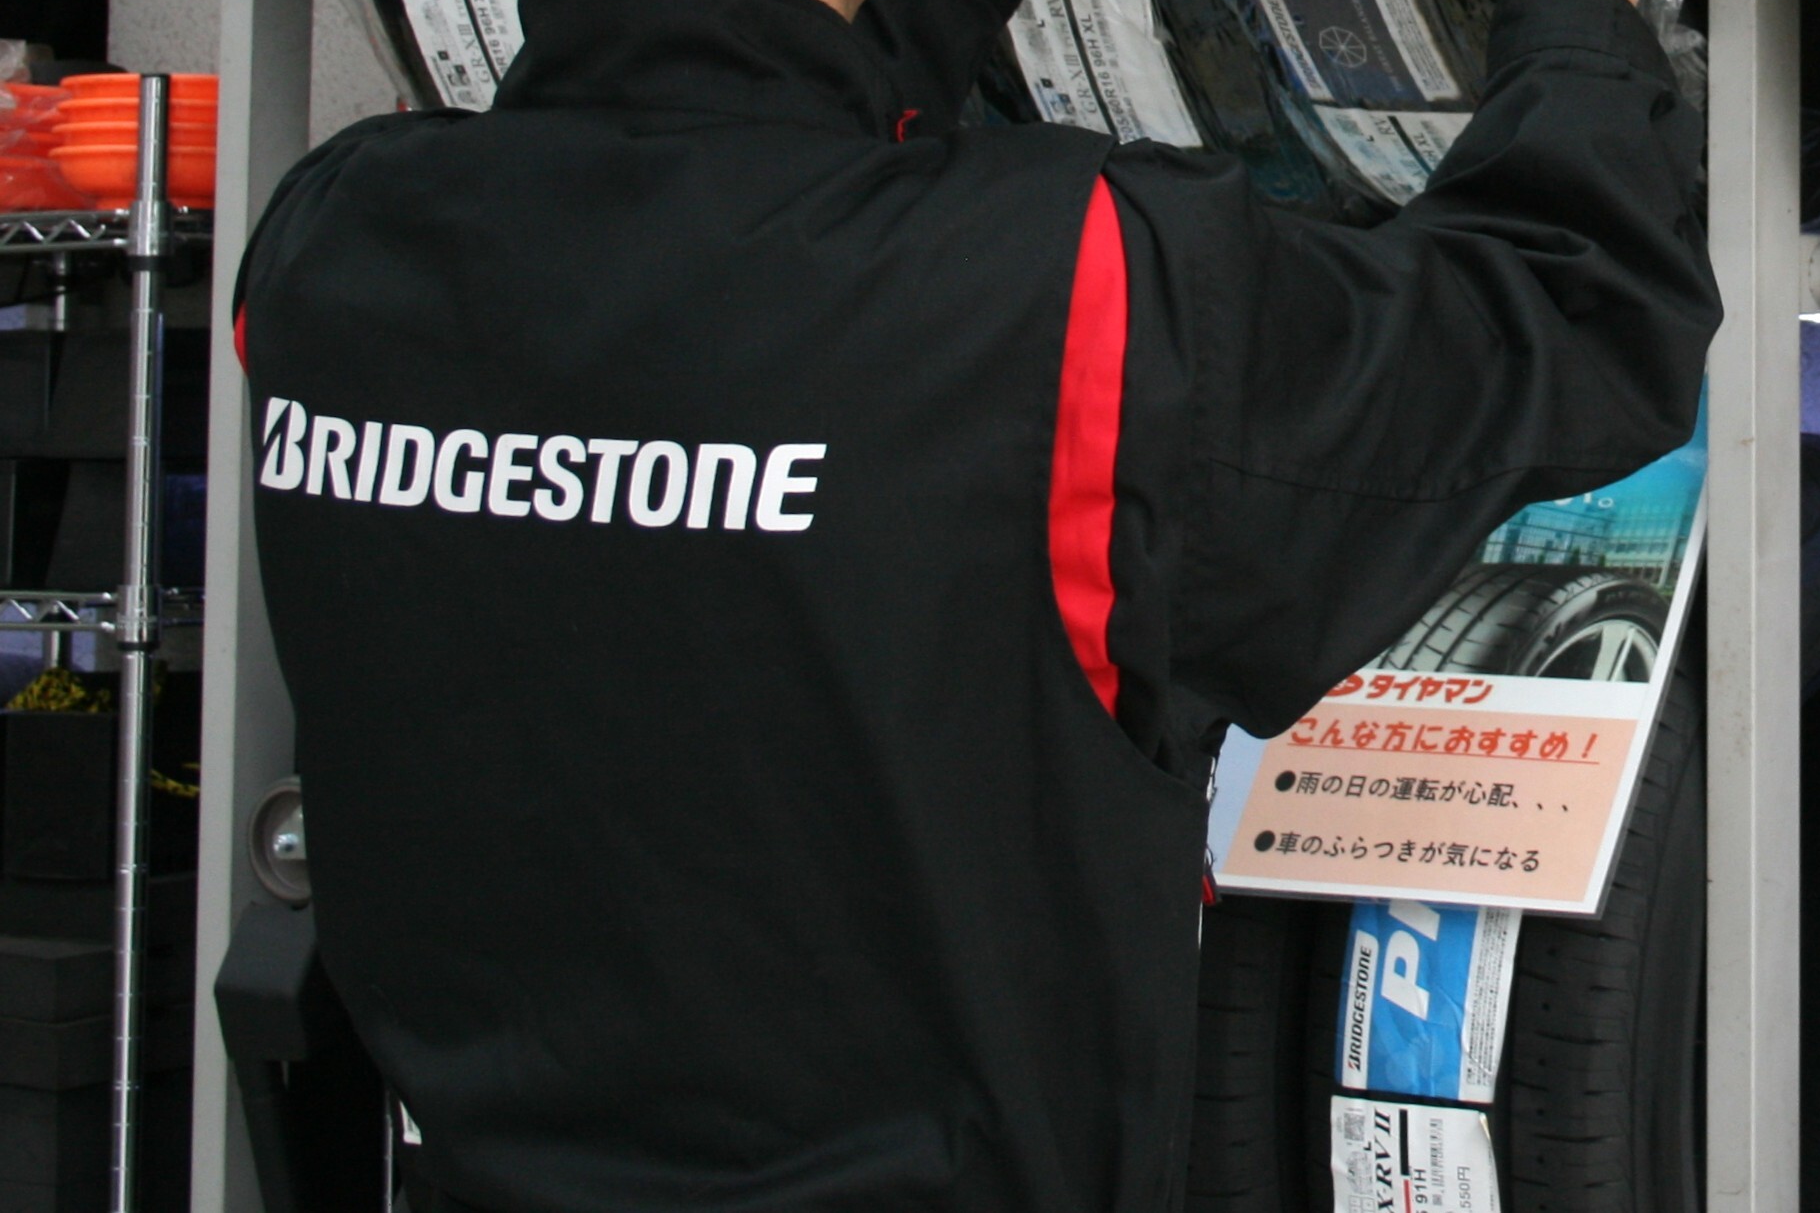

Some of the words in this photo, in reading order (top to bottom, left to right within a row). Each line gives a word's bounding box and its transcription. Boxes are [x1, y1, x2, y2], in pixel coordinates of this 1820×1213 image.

[259, 395, 828, 532] BRIDGESTONE
[1366, 674, 1493, 704] タイヤマン
[1347, 945, 1373, 1071] BRIDGESTONE
